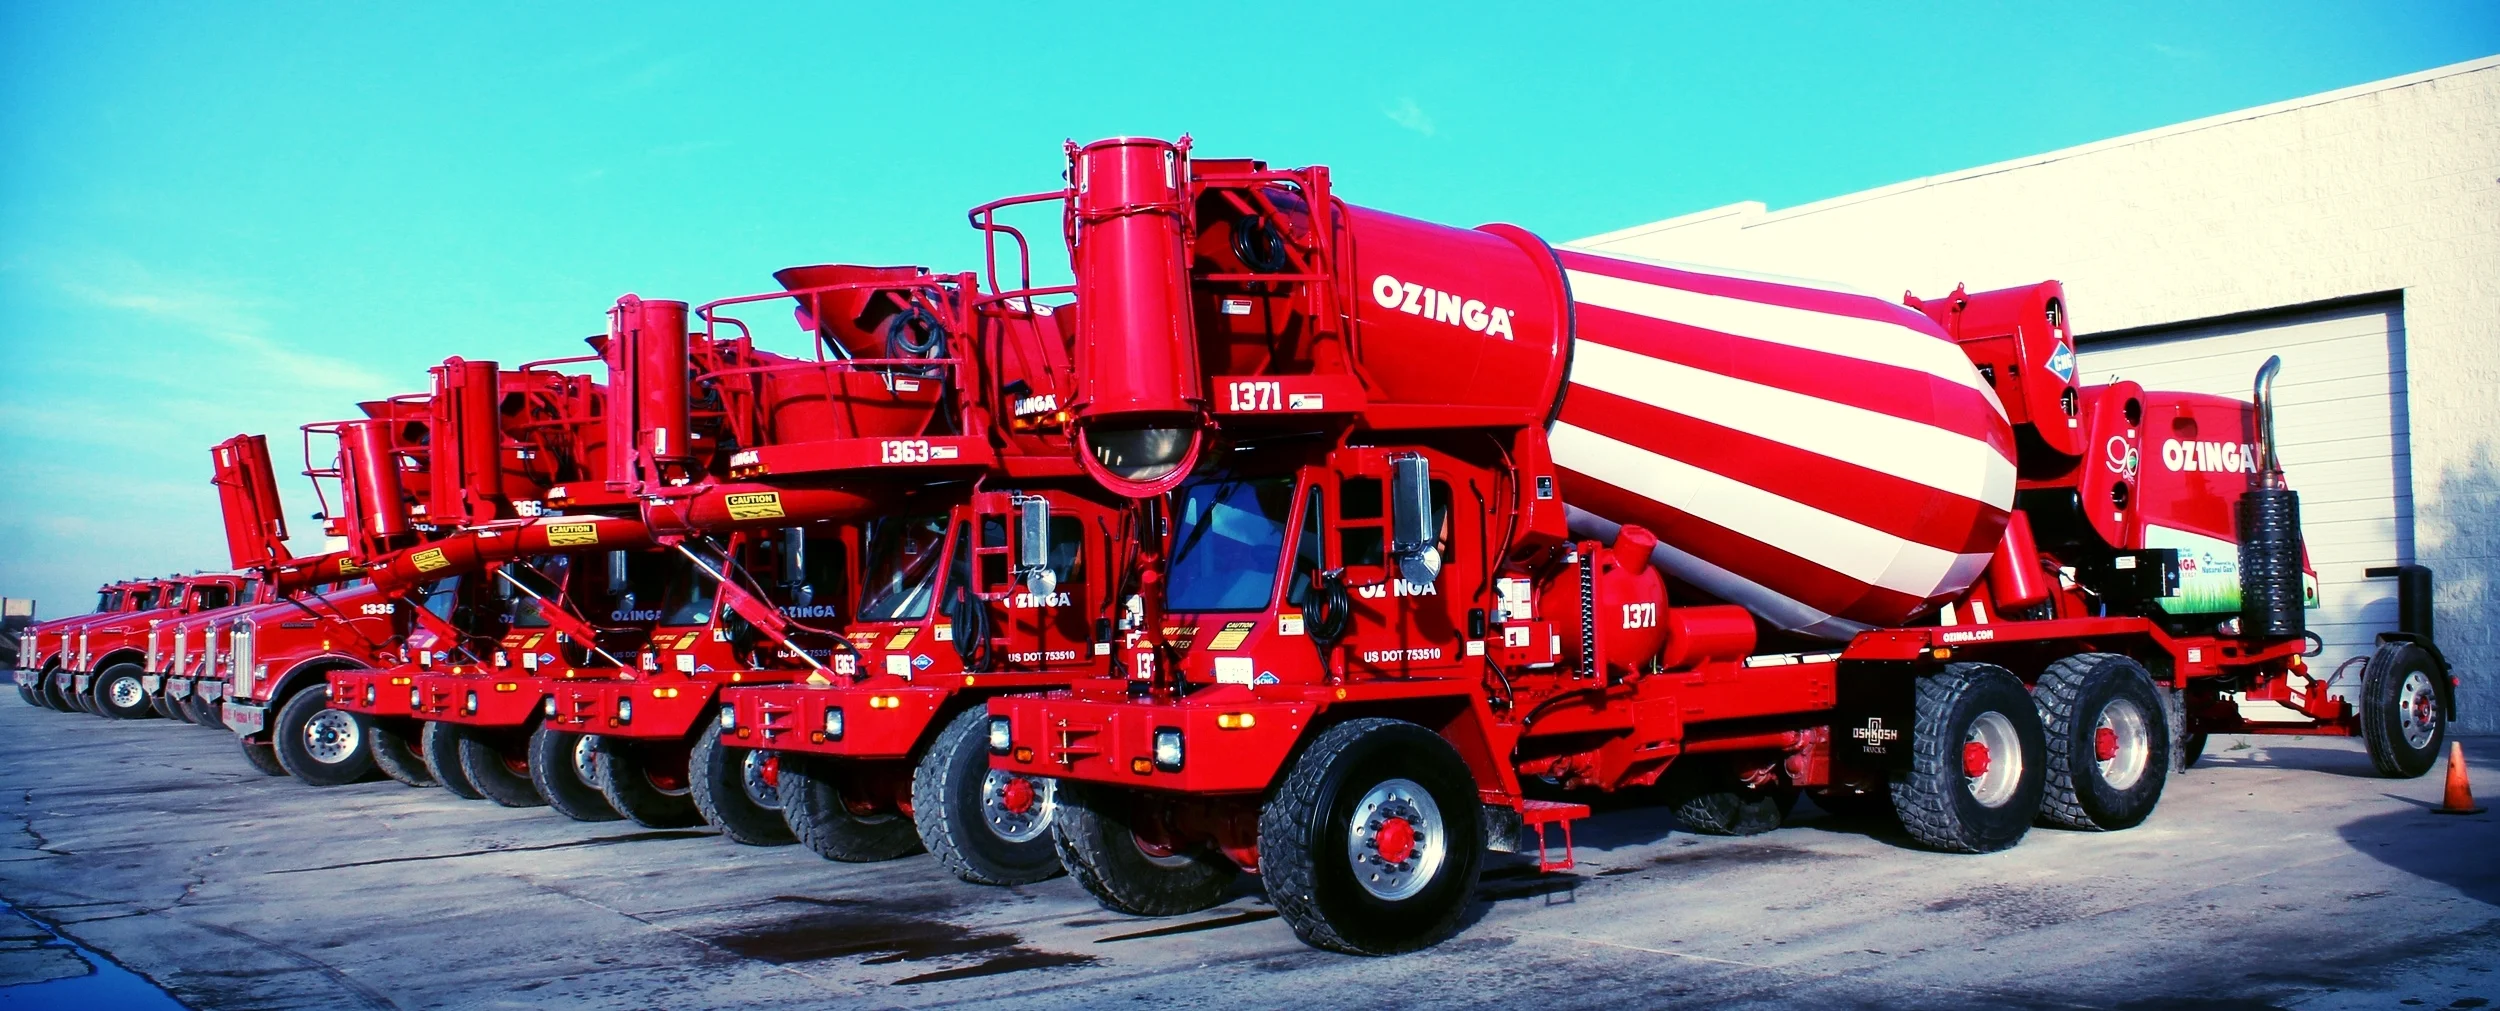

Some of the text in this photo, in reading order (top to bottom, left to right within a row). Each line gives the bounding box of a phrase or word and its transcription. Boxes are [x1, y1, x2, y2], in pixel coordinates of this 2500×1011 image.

[1372, 274, 1515, 341] OZINGA
[2053, 353, 2073, 372] CNG
[1229, 381, 1282, 411] 1371
[880, 440, 929, 464] 1363
[2162, 438, 2257, 473] OZINGA
[730, 494, 773, 505] CAUTION
[551, 525, 590, 533] CAUTION
[1358, 579, 1437, 599] OZNGA
[360, 603, 394, 615] 1335
[1622, 602, 1656, 629] 1371
[1943, 630, 1994, 642] OZINGA.COM
[835, 654, 855, 675] 1363
[1008, 651, 1075, 662] US DOT 753510
[1364, 648, 1440, 663] US DOT 753510
[1852, 720, 1898, 742] OSHKOSH
[1863, 746, 1887, 754] TRUCKS
